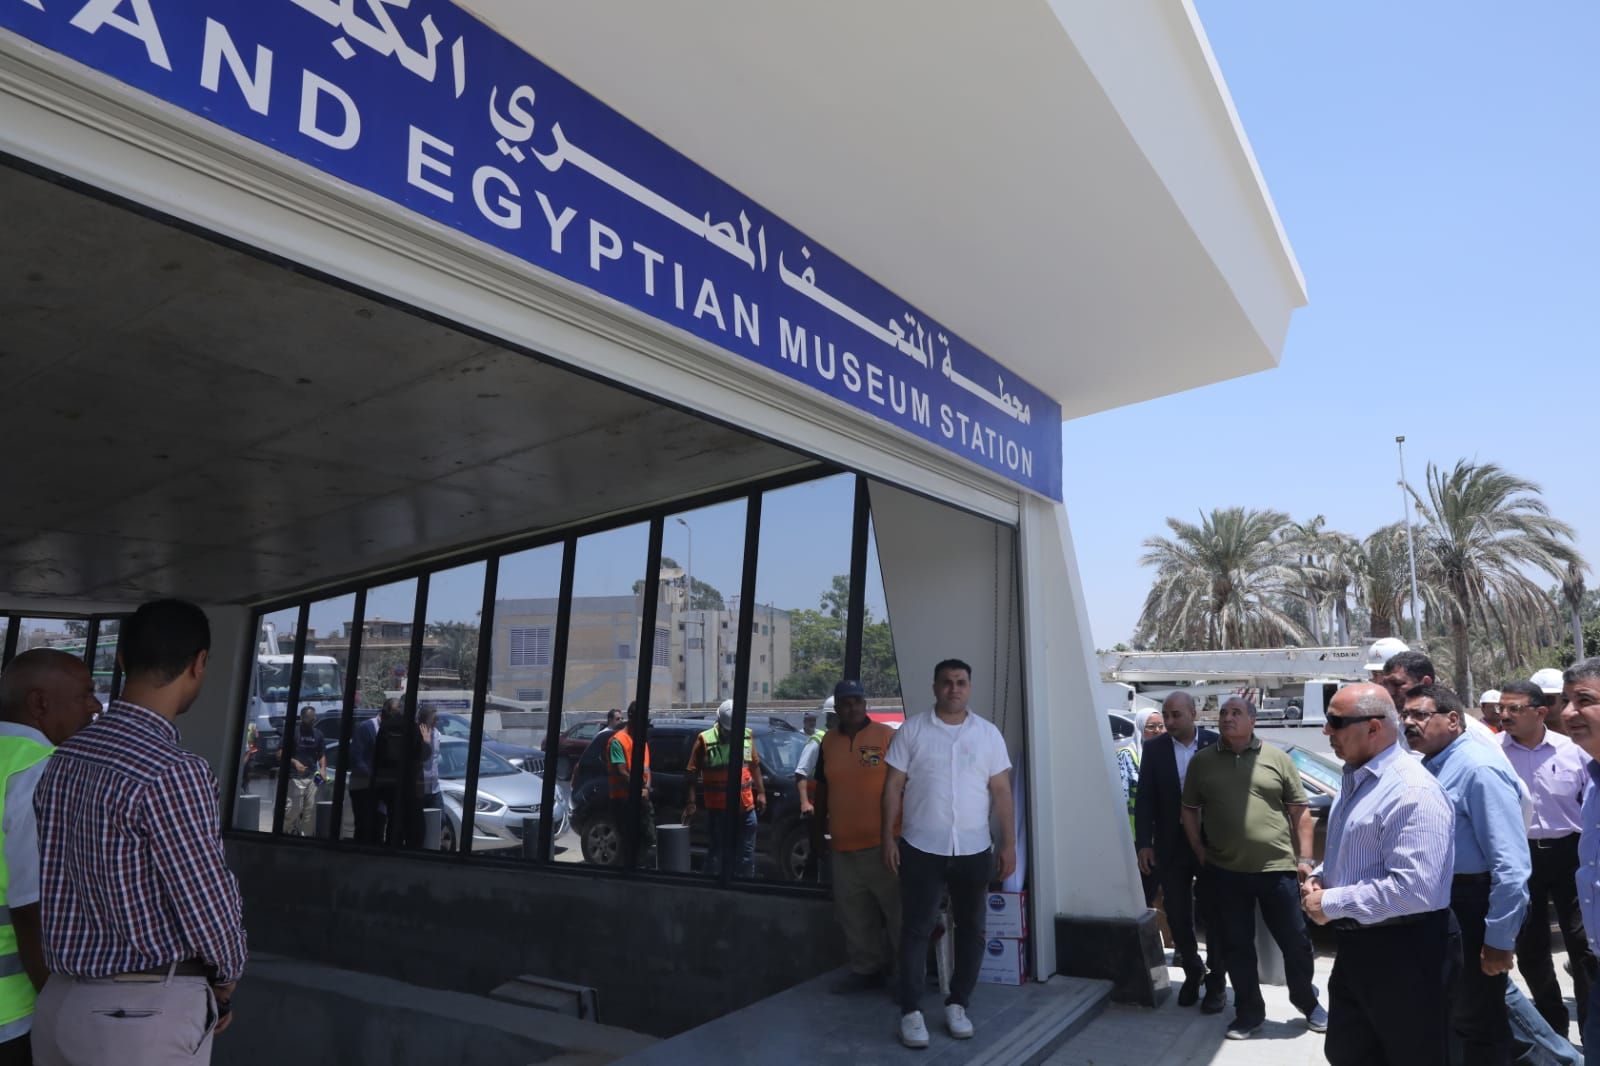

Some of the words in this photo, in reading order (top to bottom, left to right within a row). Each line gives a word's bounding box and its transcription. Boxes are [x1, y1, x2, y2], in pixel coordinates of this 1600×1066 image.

[22, 0, 361, 151] AND
[406, 124, 761, 347] EGYPTIAN
[778, 316, 931, 429] MUSEUM
[940, 403, 1033, 478] STATION
[489, 84, 767, 273] المصري
[778, 245, 934, 370] المتحف
[937, 332, 1032, 425] محطة
